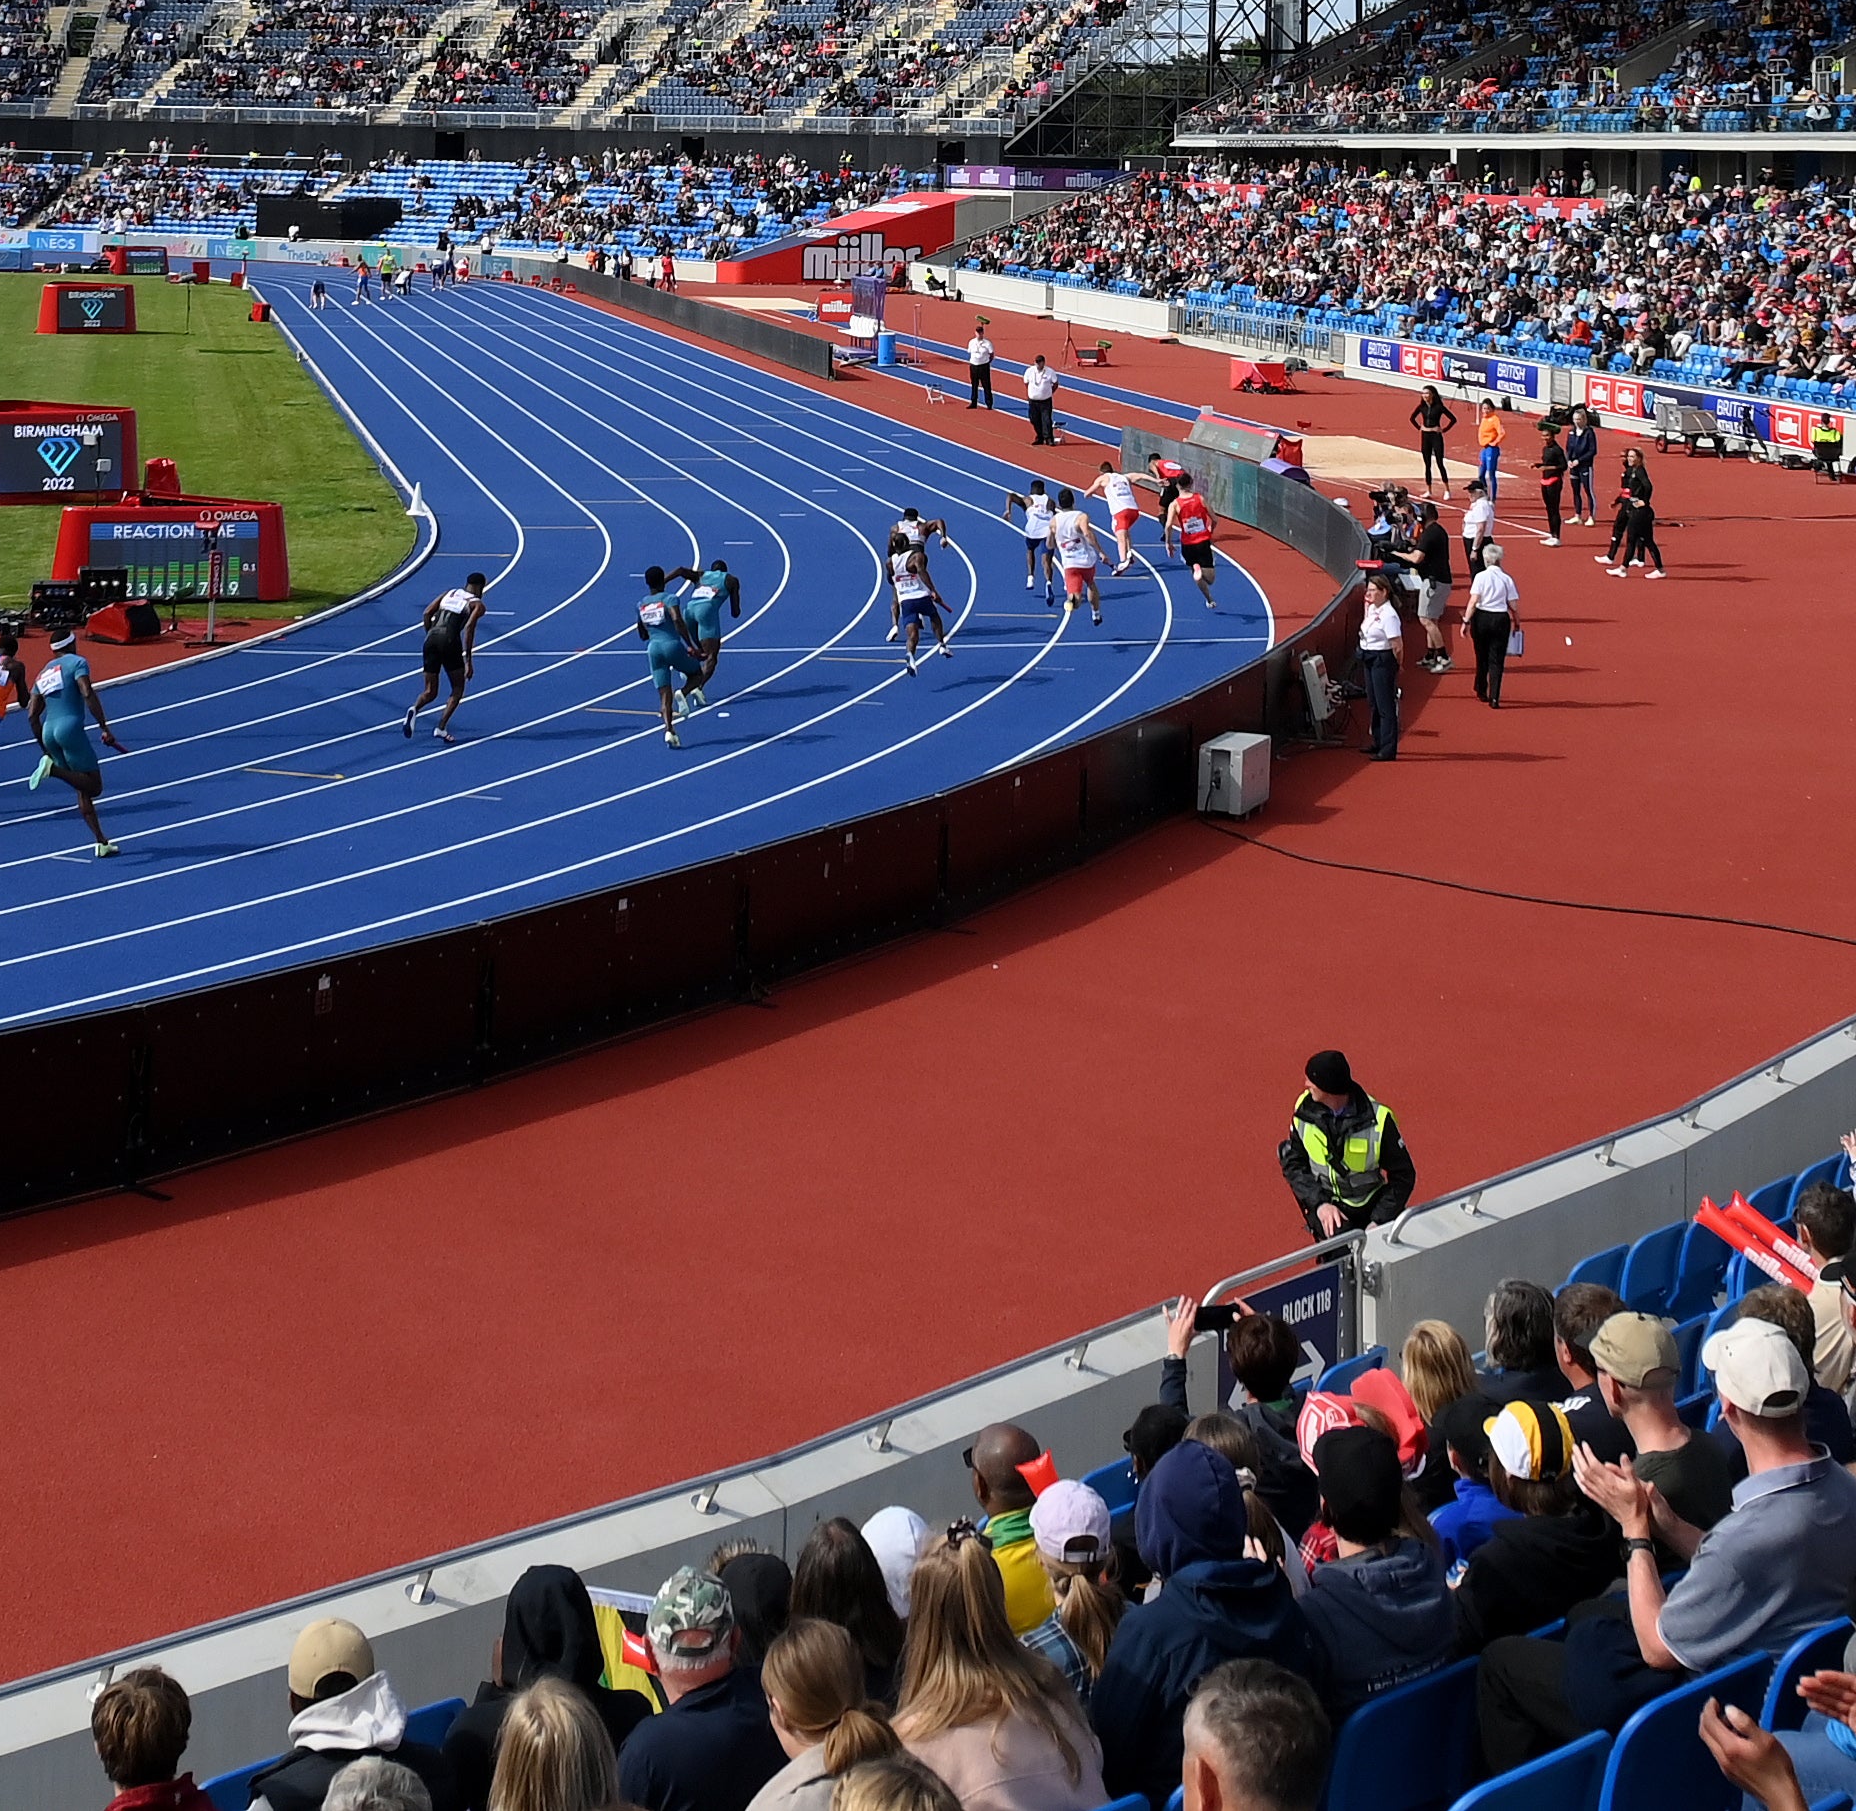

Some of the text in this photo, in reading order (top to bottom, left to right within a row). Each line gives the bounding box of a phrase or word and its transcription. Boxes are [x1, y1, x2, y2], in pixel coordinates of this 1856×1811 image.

[36, 237, 76, 250] INEOS
[288, 250, 305, 260] The
[305, 250, 327, 263] Daily
[821, 300, 853, 313] müller
[1497, 362, 1526, 381] BRITISH
[86, 413, 119, 422] OMEGA
[14, 424, 104, 439] BIRMINGHAM
[42, 477, 75, 491] 2022
[214, 510, 258, 521] OMEGA
[113, 524, 195, 539] REACTION
[137, 582, 149, 597] 3
[152, 582, 164, 597] 4
[228, 581, 239, 596] 9
[1282, 1288, 1332, 1326] BLOCK 118
